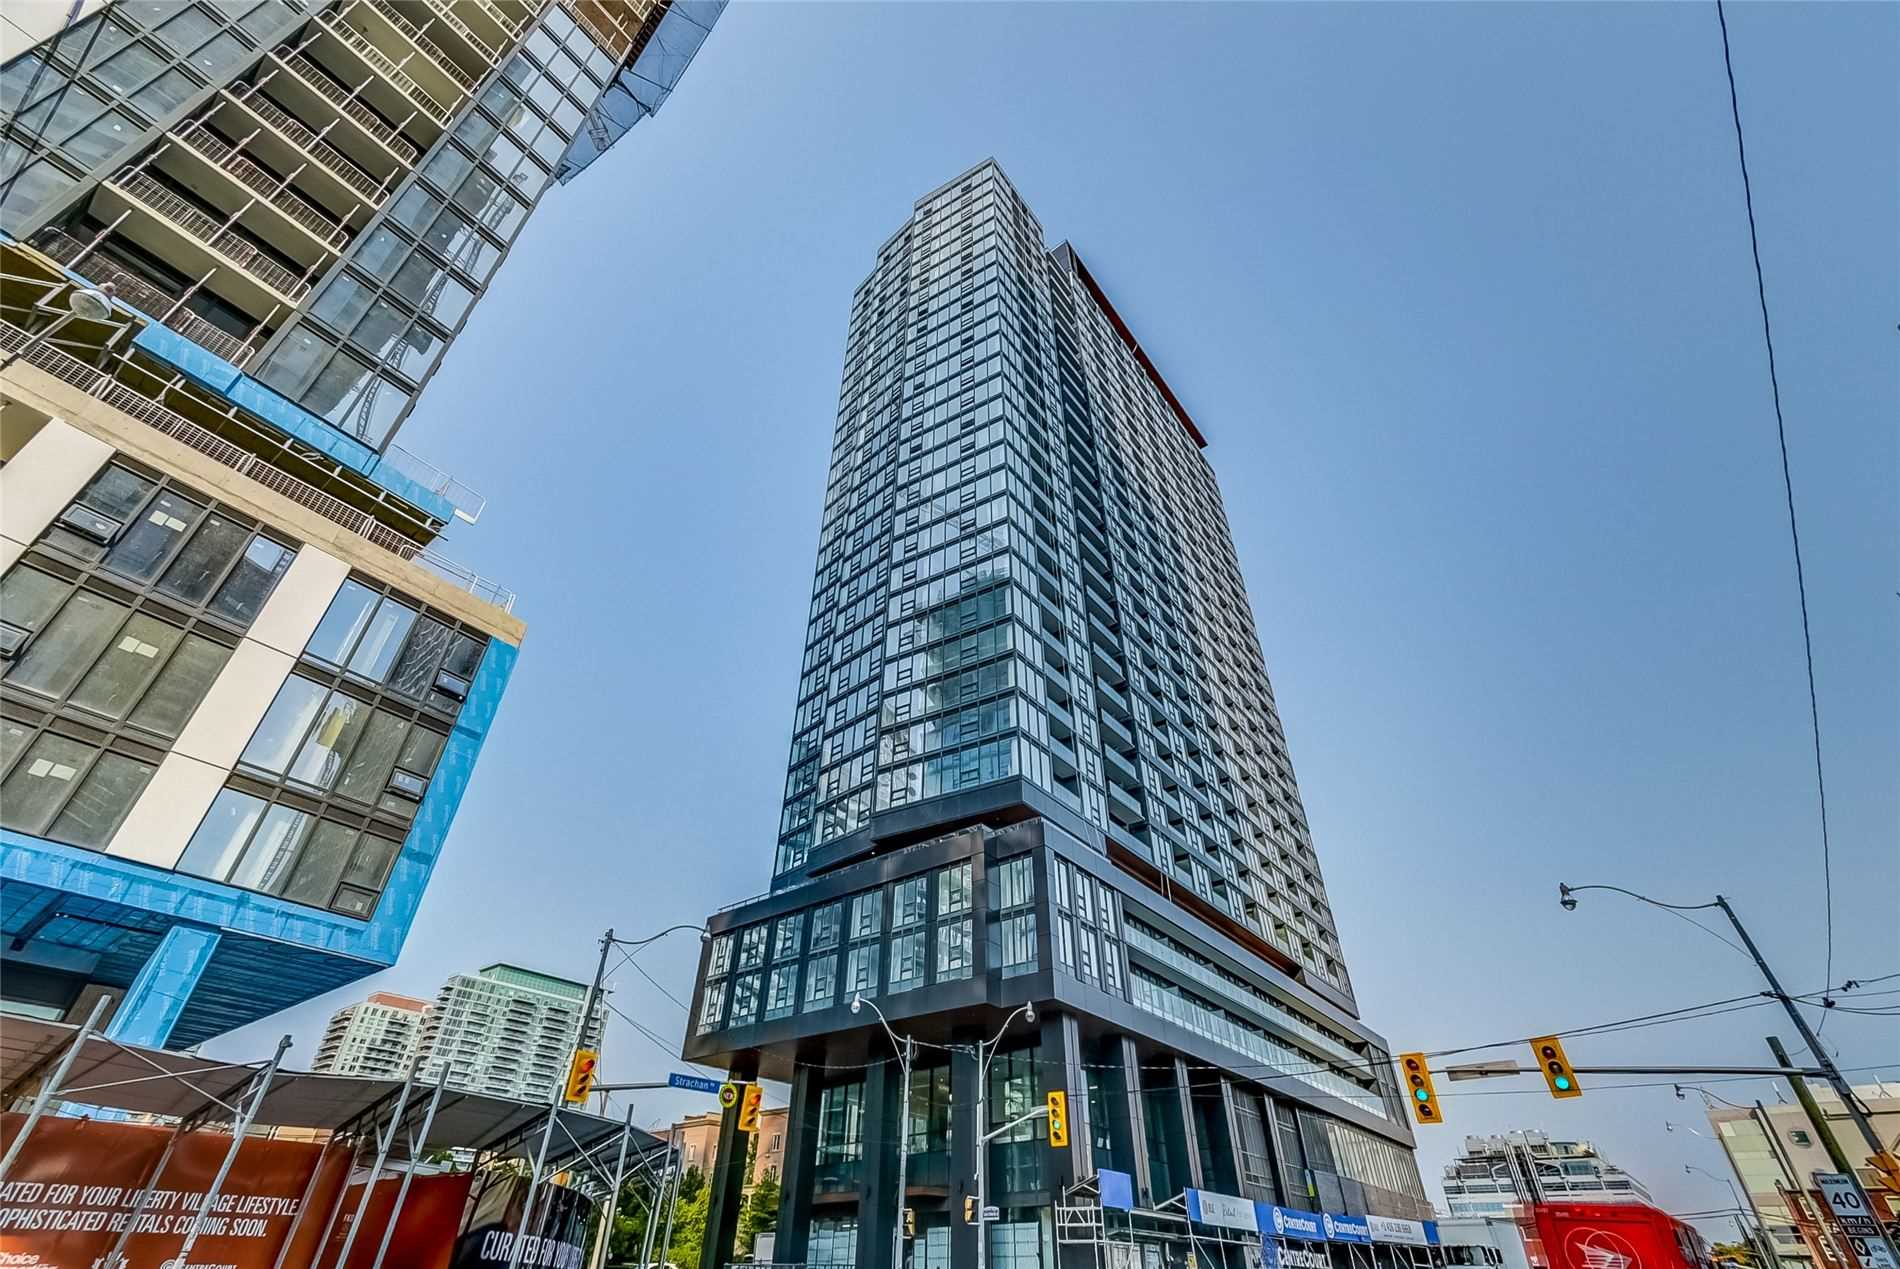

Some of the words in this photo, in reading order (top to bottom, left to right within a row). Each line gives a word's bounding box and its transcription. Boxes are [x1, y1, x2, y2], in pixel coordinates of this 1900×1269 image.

[674, 1075, 709, 1089] Strachan
[0, 1181, 45, 1204] ATED
[42, 1183, 79, 1205] FOR
[79, 1185, 122, 1208] YOUR
[181, 1191, 238, 1213] VILAGE
[235, 1195, 301, 1216] LIFESTYLE
[1832, 1191, 1861, 1209] 40
[229, 1218, 269, 1237] SOON.
[1840, 1217, 1872, 1225] km/h
